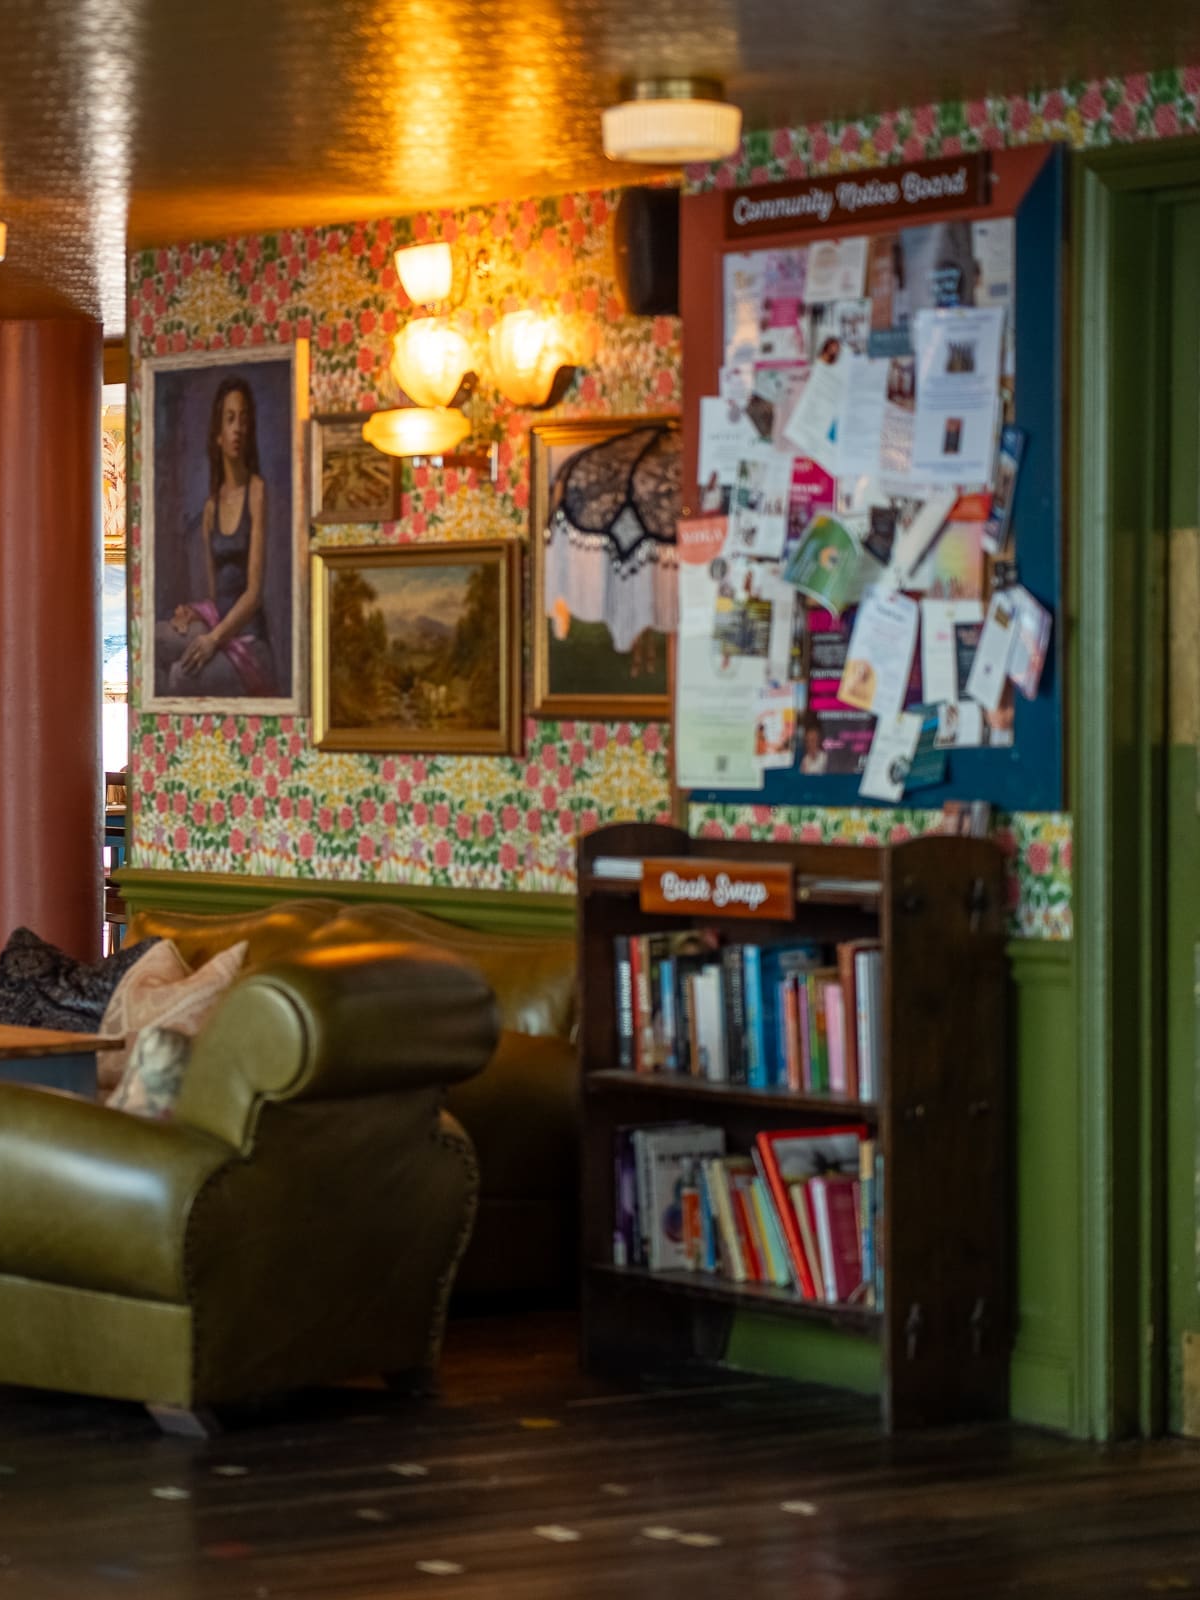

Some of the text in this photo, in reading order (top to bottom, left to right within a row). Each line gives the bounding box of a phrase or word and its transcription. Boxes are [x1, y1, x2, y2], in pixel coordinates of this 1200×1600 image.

[733, 167, 967, 224] Community Notice Board
[660, 871, 768, 911] Book Swap
